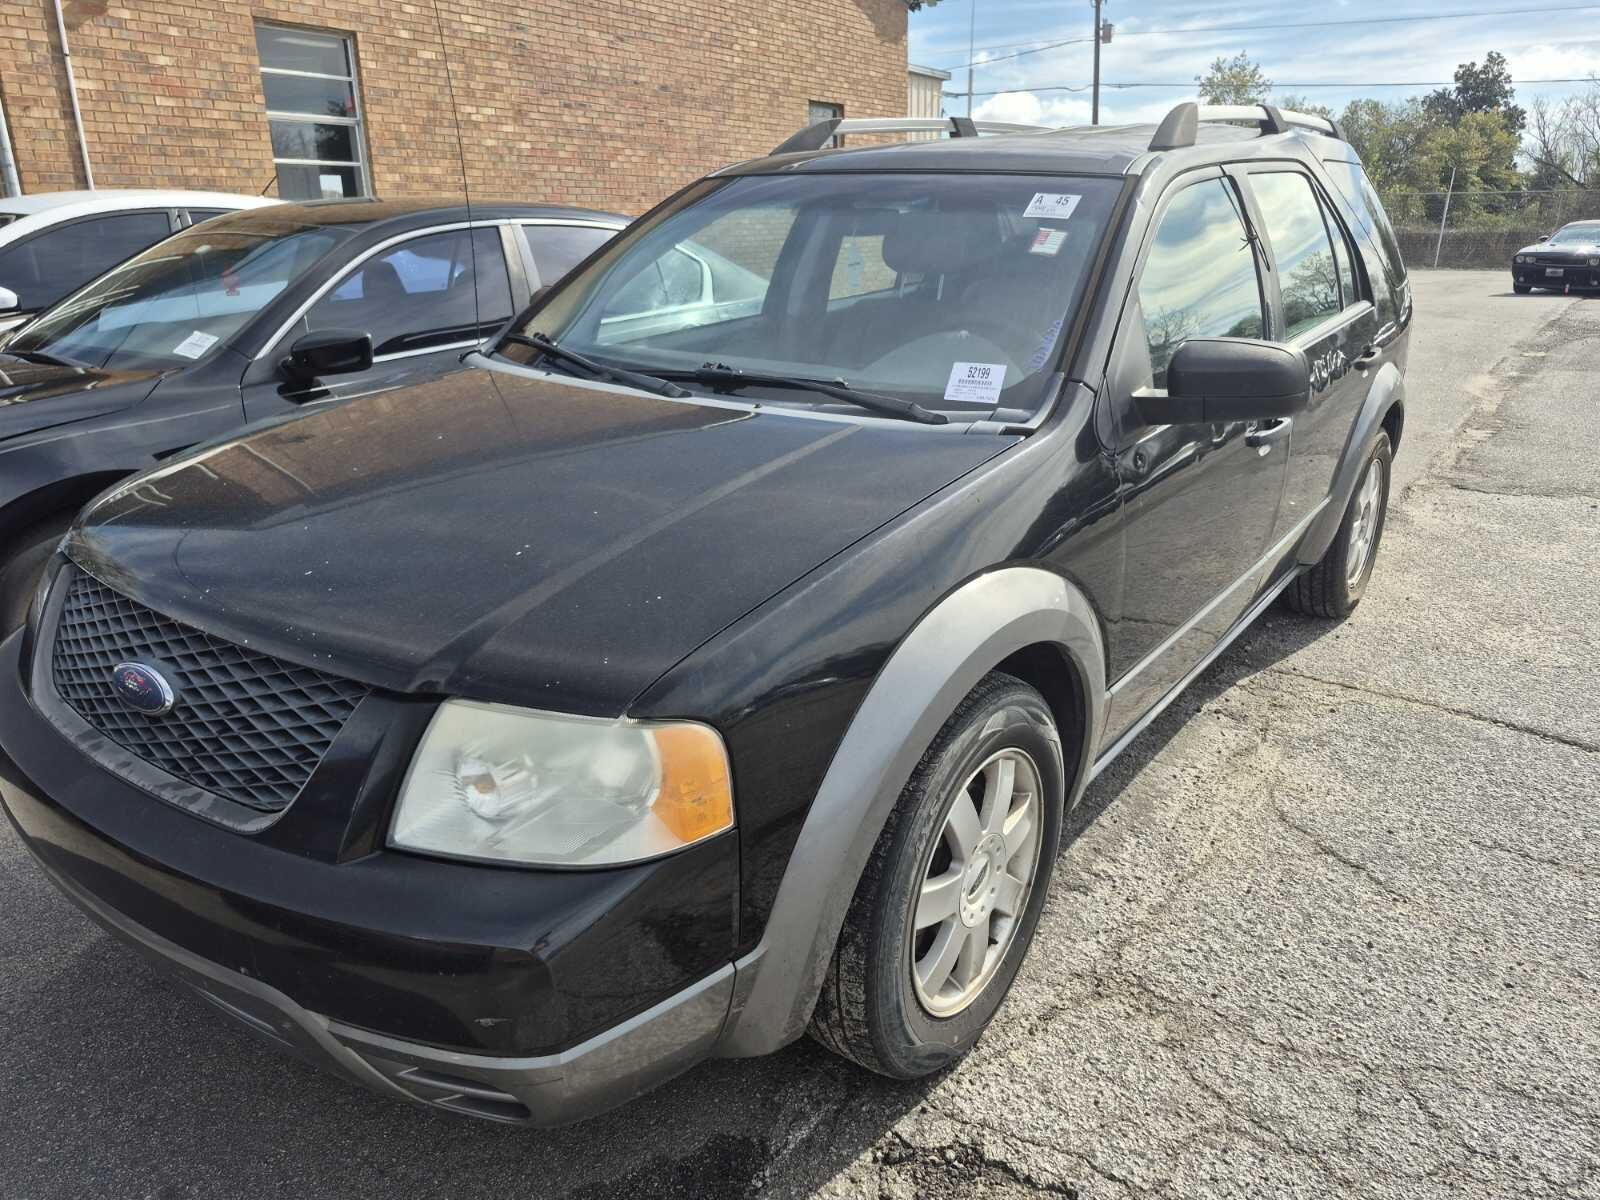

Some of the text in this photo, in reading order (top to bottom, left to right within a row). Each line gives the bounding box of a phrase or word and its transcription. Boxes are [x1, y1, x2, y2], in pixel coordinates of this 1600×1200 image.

[1034, 195, 1071, 206] A 45
[967, 366, 991, 379] 52199
